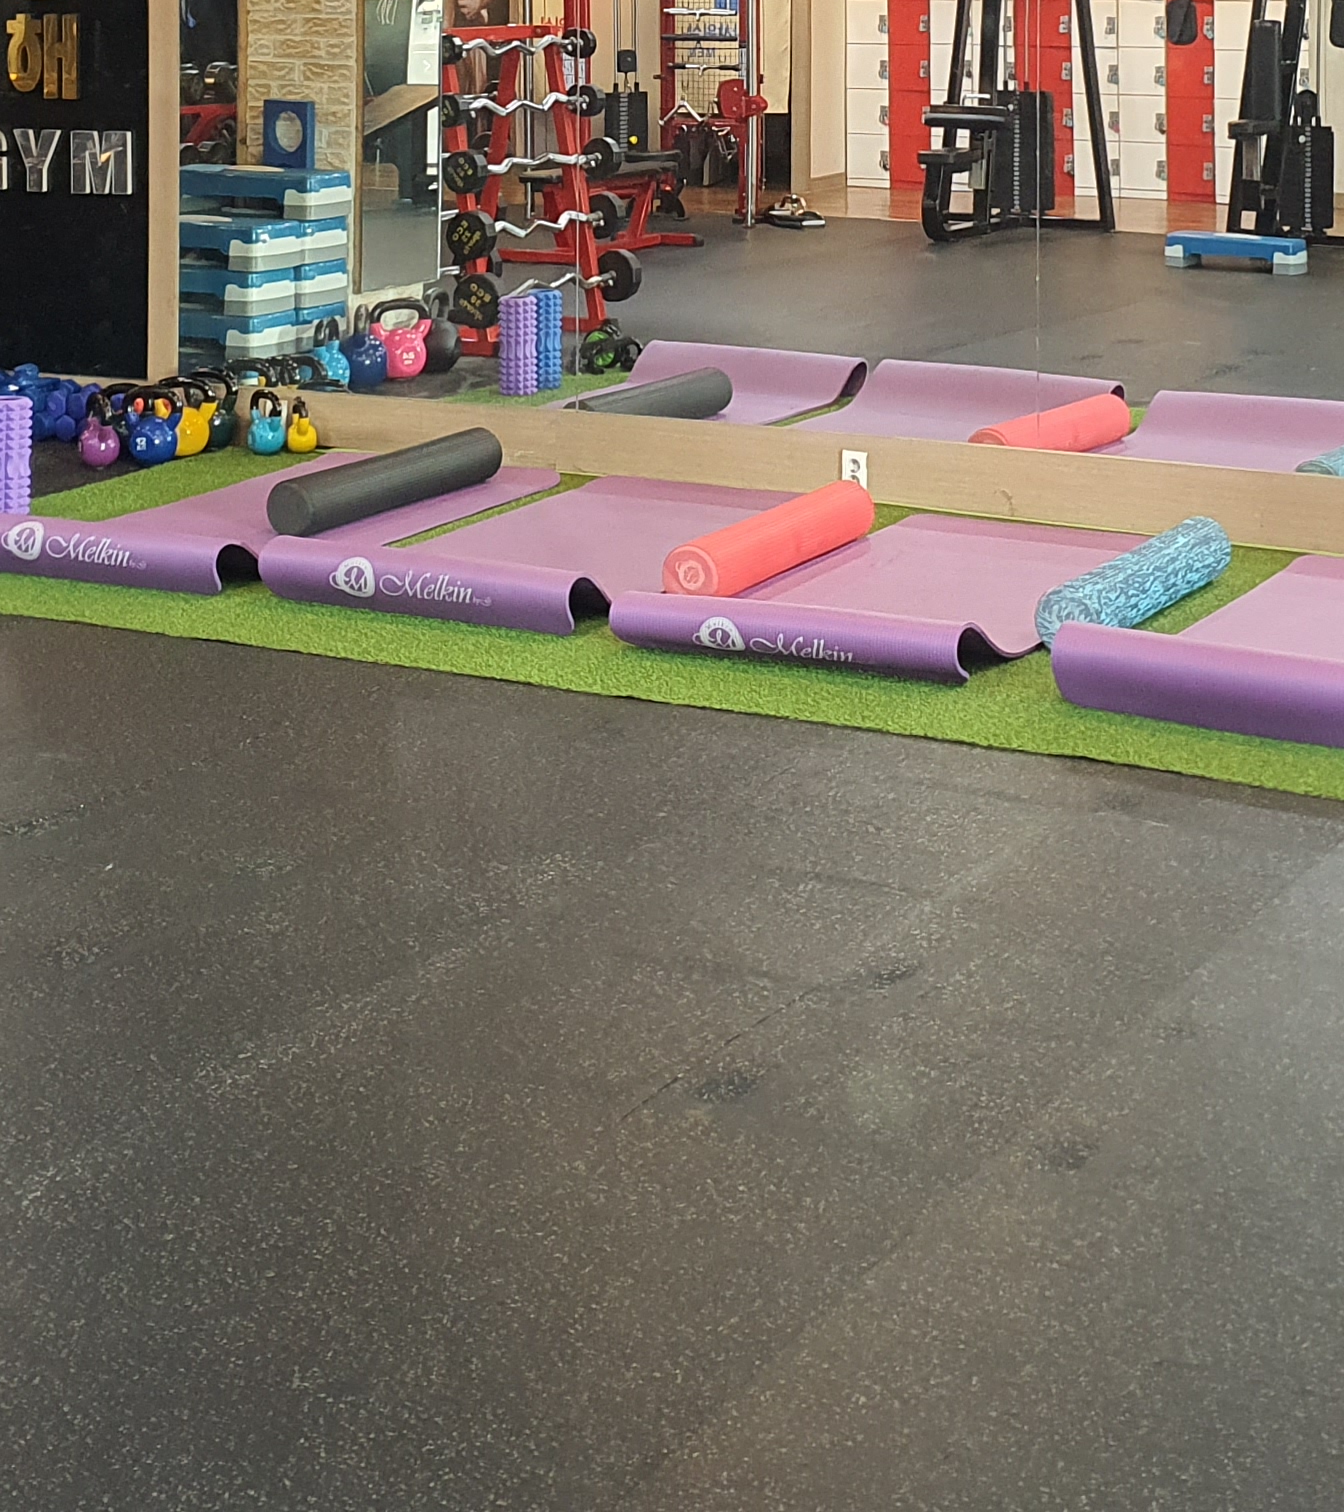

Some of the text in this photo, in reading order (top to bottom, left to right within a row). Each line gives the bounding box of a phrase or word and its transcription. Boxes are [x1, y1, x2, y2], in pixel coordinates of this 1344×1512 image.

[45, 532, 131, 568] Melkin
[379, 569, 474, 605] Melkin
[749, 632, 854, 663] Melkin
